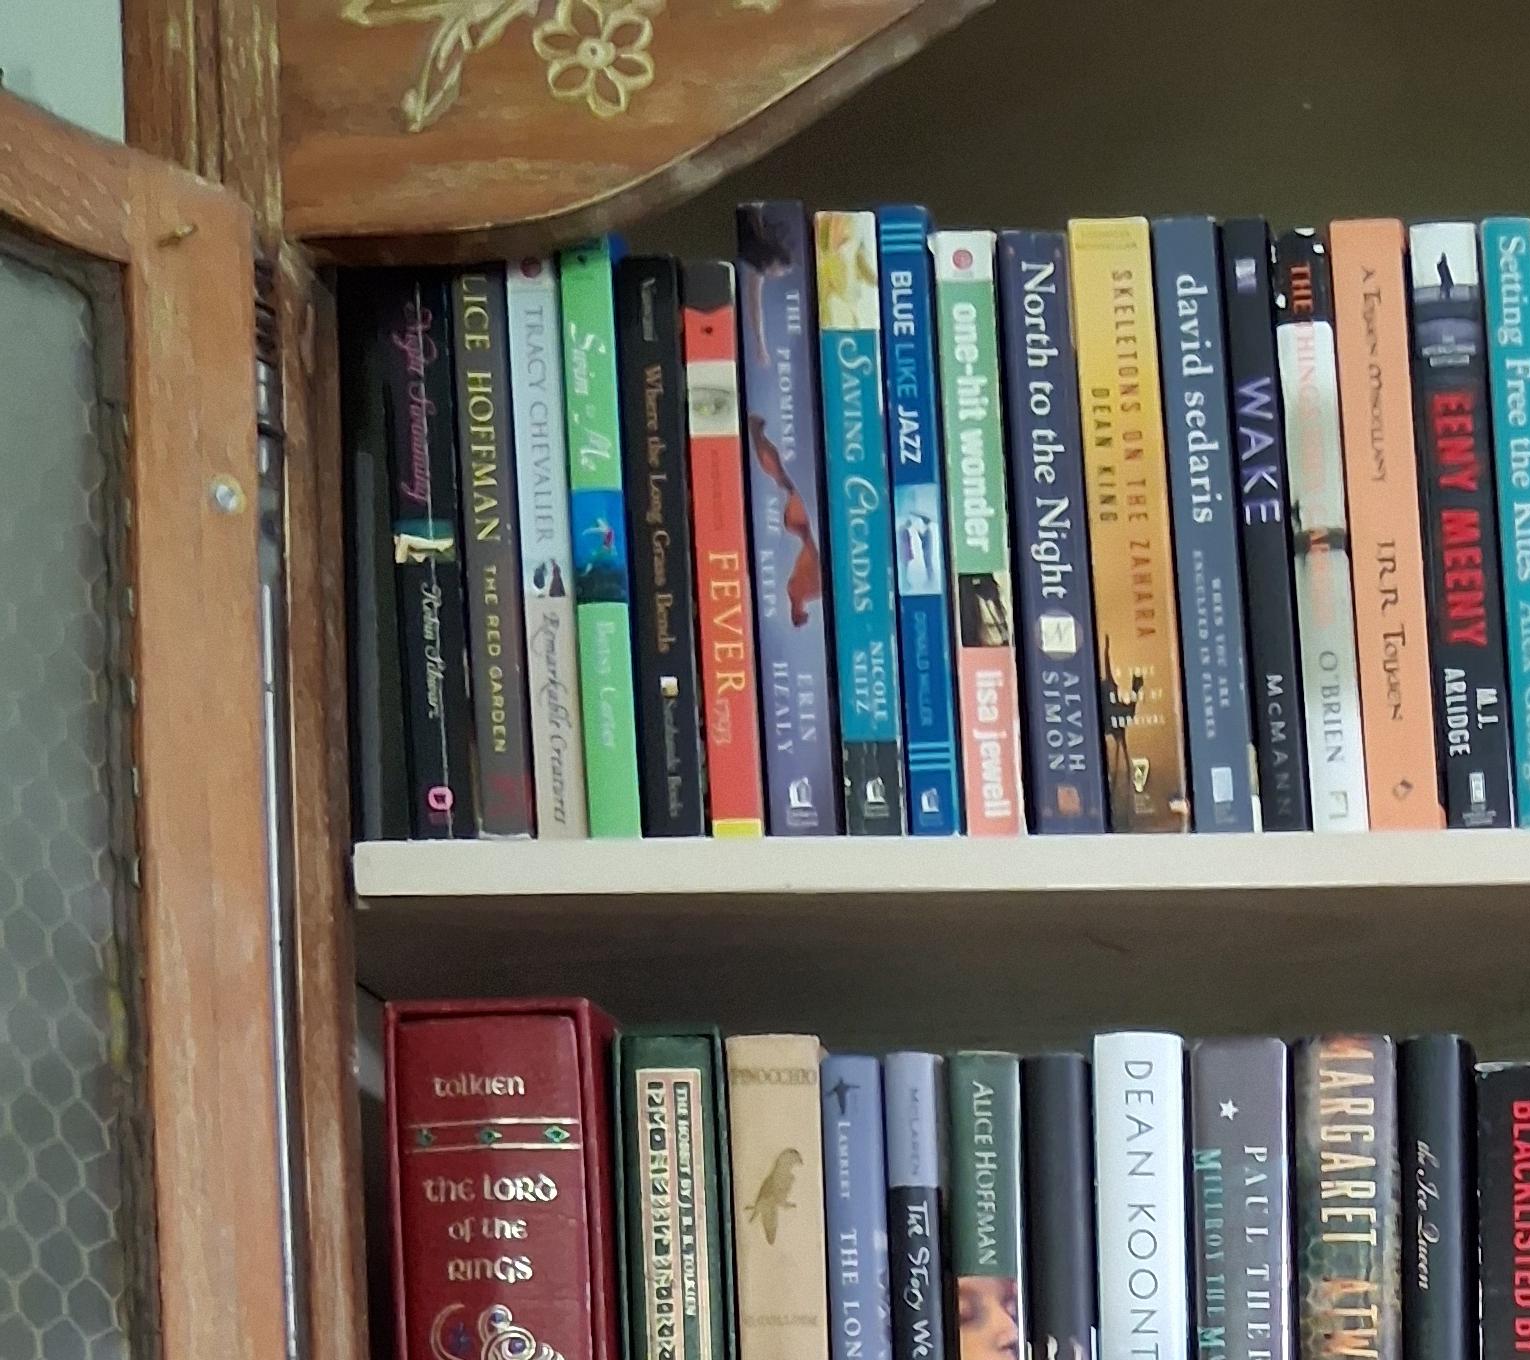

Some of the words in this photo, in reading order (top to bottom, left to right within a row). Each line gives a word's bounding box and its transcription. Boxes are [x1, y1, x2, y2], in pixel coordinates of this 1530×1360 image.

[889, 271, 914, 338] BLUE
[1022, 261, 1055, 369] North
[1175, 273, 1214, 378] david
[1498, 235, 1527, 348] Setting
[952, 302, 980, 414] one-hit
[1028, 380, 1052, 411] to
[898, 402, 922, 465] JAZZ
[1031, 421, 1058, 486] the
[1185, 391, 1219, 523] sedaris
[1234, 377, 1280, 525] WAKE
[1434, 392, 1478, 492] EENY
[1509, 434, 1530, 488] the
[958, 422, 989, 553] wonder
[1031, 498, 1071, 600] Night
[1440, 508, 1488, 646] MEENY
[708, 550, 746, 694] FEVER
[1123, 1059, 1154, 1177] DEAN
[423, 1176, 475, 1203] the
[448, 1219, 475, 1241] of
[481, 1218, 527, 1240] the
[840, 1229, 858, 1286] THE
